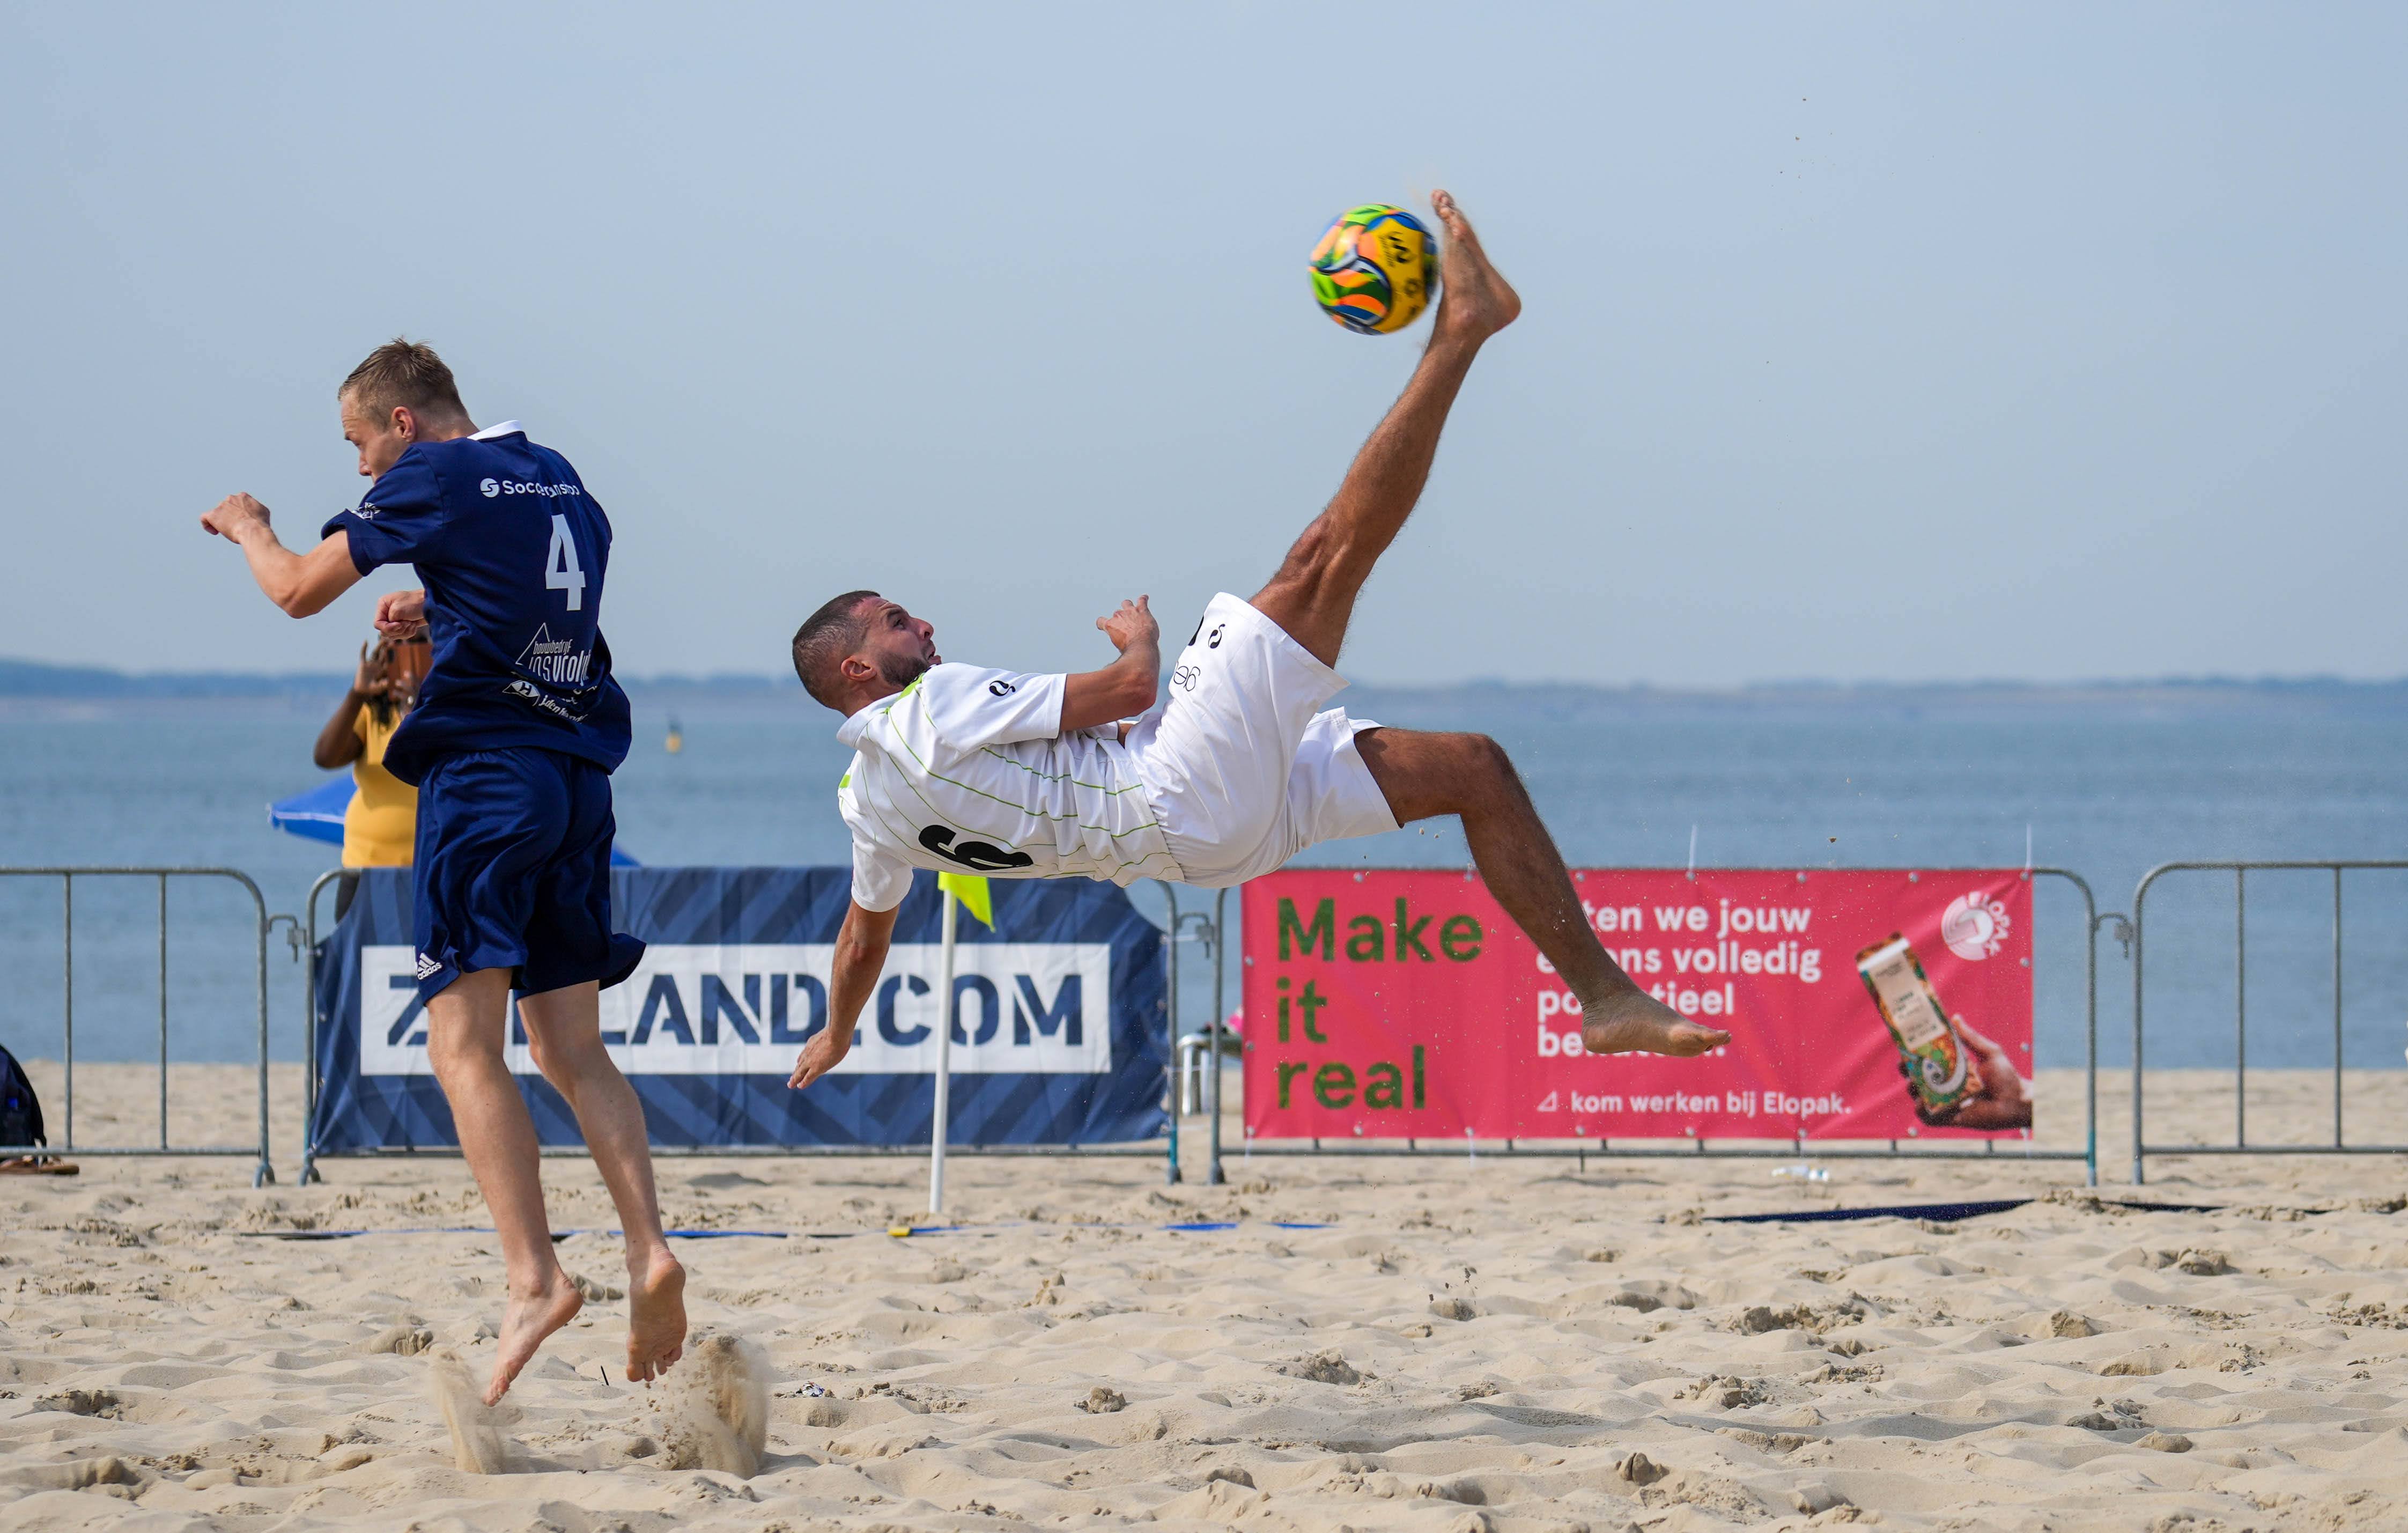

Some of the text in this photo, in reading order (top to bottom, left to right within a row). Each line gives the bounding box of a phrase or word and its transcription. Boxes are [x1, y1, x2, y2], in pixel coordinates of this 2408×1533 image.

[545, 513, 586, 611] 4
[533, 639, 574, 655] bouwbedrijf
[1277, 897, 1483, 963] Make
[1653, 906, 1709, 932] we
[1716, 897, 1812, 939] jouw
[417, 962, 443, 981] adidas
[1672, 940, 1822, 983] volledig
[1276, 976, 1328, 1044] it
[1277, 1044, 1426, 1109] real
[1571, 1090, 1852, 1119] kom werken bij Elopak.
